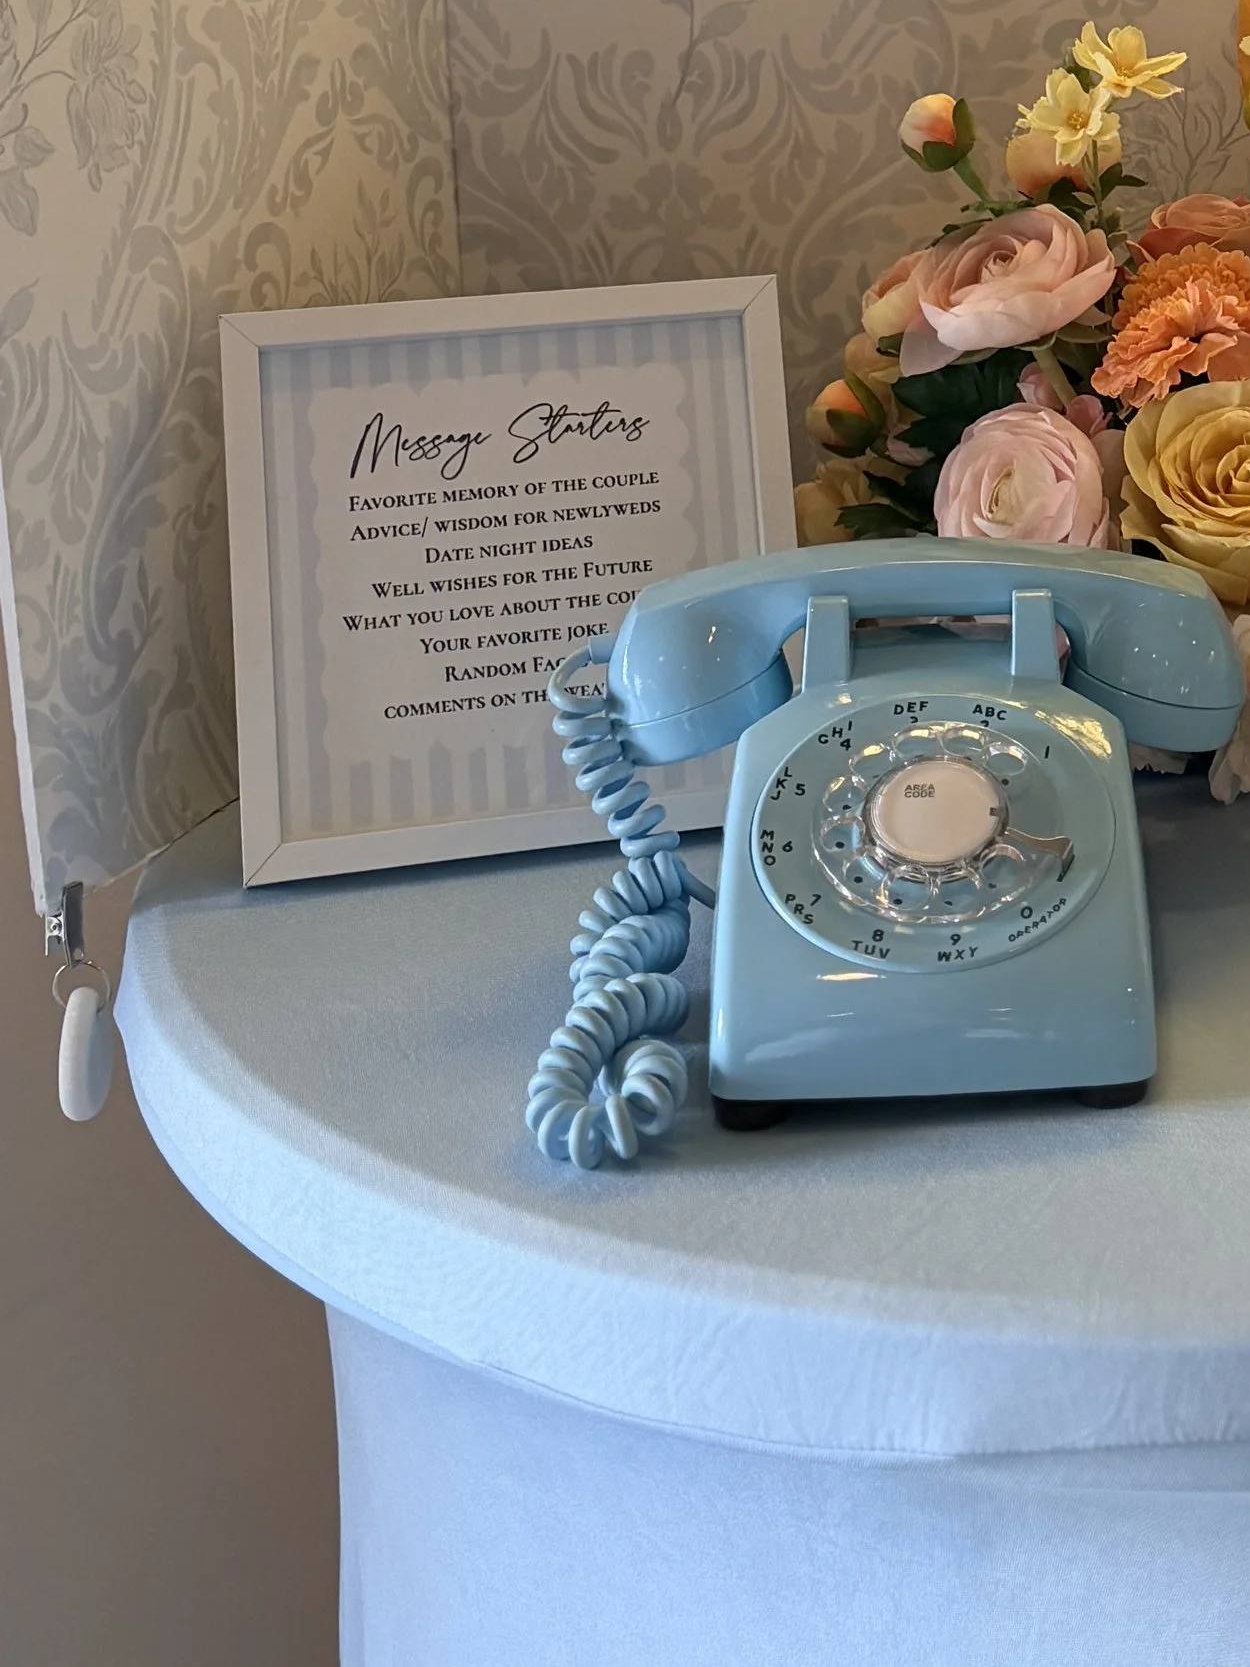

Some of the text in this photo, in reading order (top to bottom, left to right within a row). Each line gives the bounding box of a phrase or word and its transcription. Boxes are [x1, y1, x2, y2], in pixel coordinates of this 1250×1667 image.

[350, 401, 650, 480] Message Starters
[520, 688, 550, 704] TH
[893, 701, 929, 715] DEF
[972, 704, 1007, 721] ABC
[840, 738, 852, 751] 4
[794, 784, 806, 797] 5
[782, 840, 793, 853] 6
[810, 894, 822, 906] 7
[1008, 898, 1067, 942] OPERATOR
[872, 929, 885, 942] 8
[950, 934, 961, 946] 9
[851, 940, 891, 959] TUV
[937, 946, 978, 962] WXY
